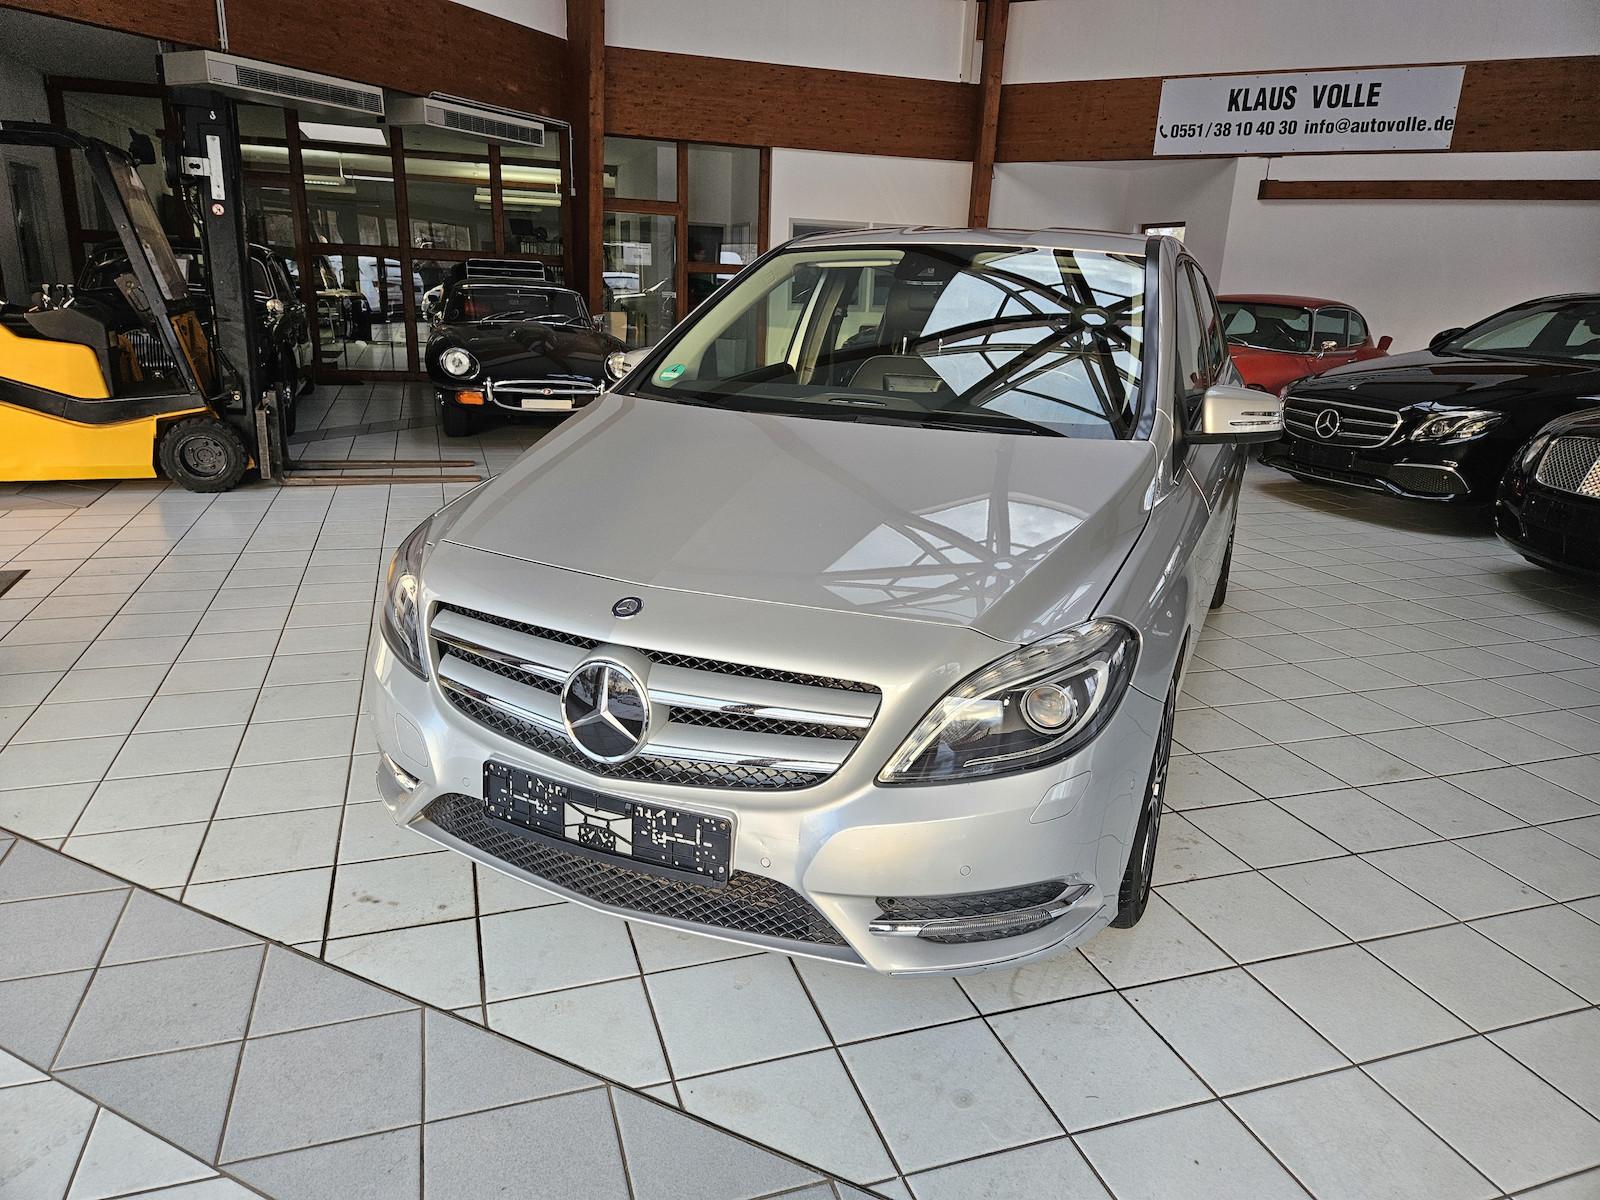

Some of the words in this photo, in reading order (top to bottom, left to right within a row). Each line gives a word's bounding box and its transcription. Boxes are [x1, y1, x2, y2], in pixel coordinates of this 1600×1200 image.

[1227, 85, 1297, 112] KLAUS
[1313, 82, 1382, 109] VOLLE
[1235, 121, 1253, 136] 10
[1256, 121, 1275, 136] 40
[1278, 120, 1298, 135] 30
[1304, 115, 1454, 134] info@autovolle.de
